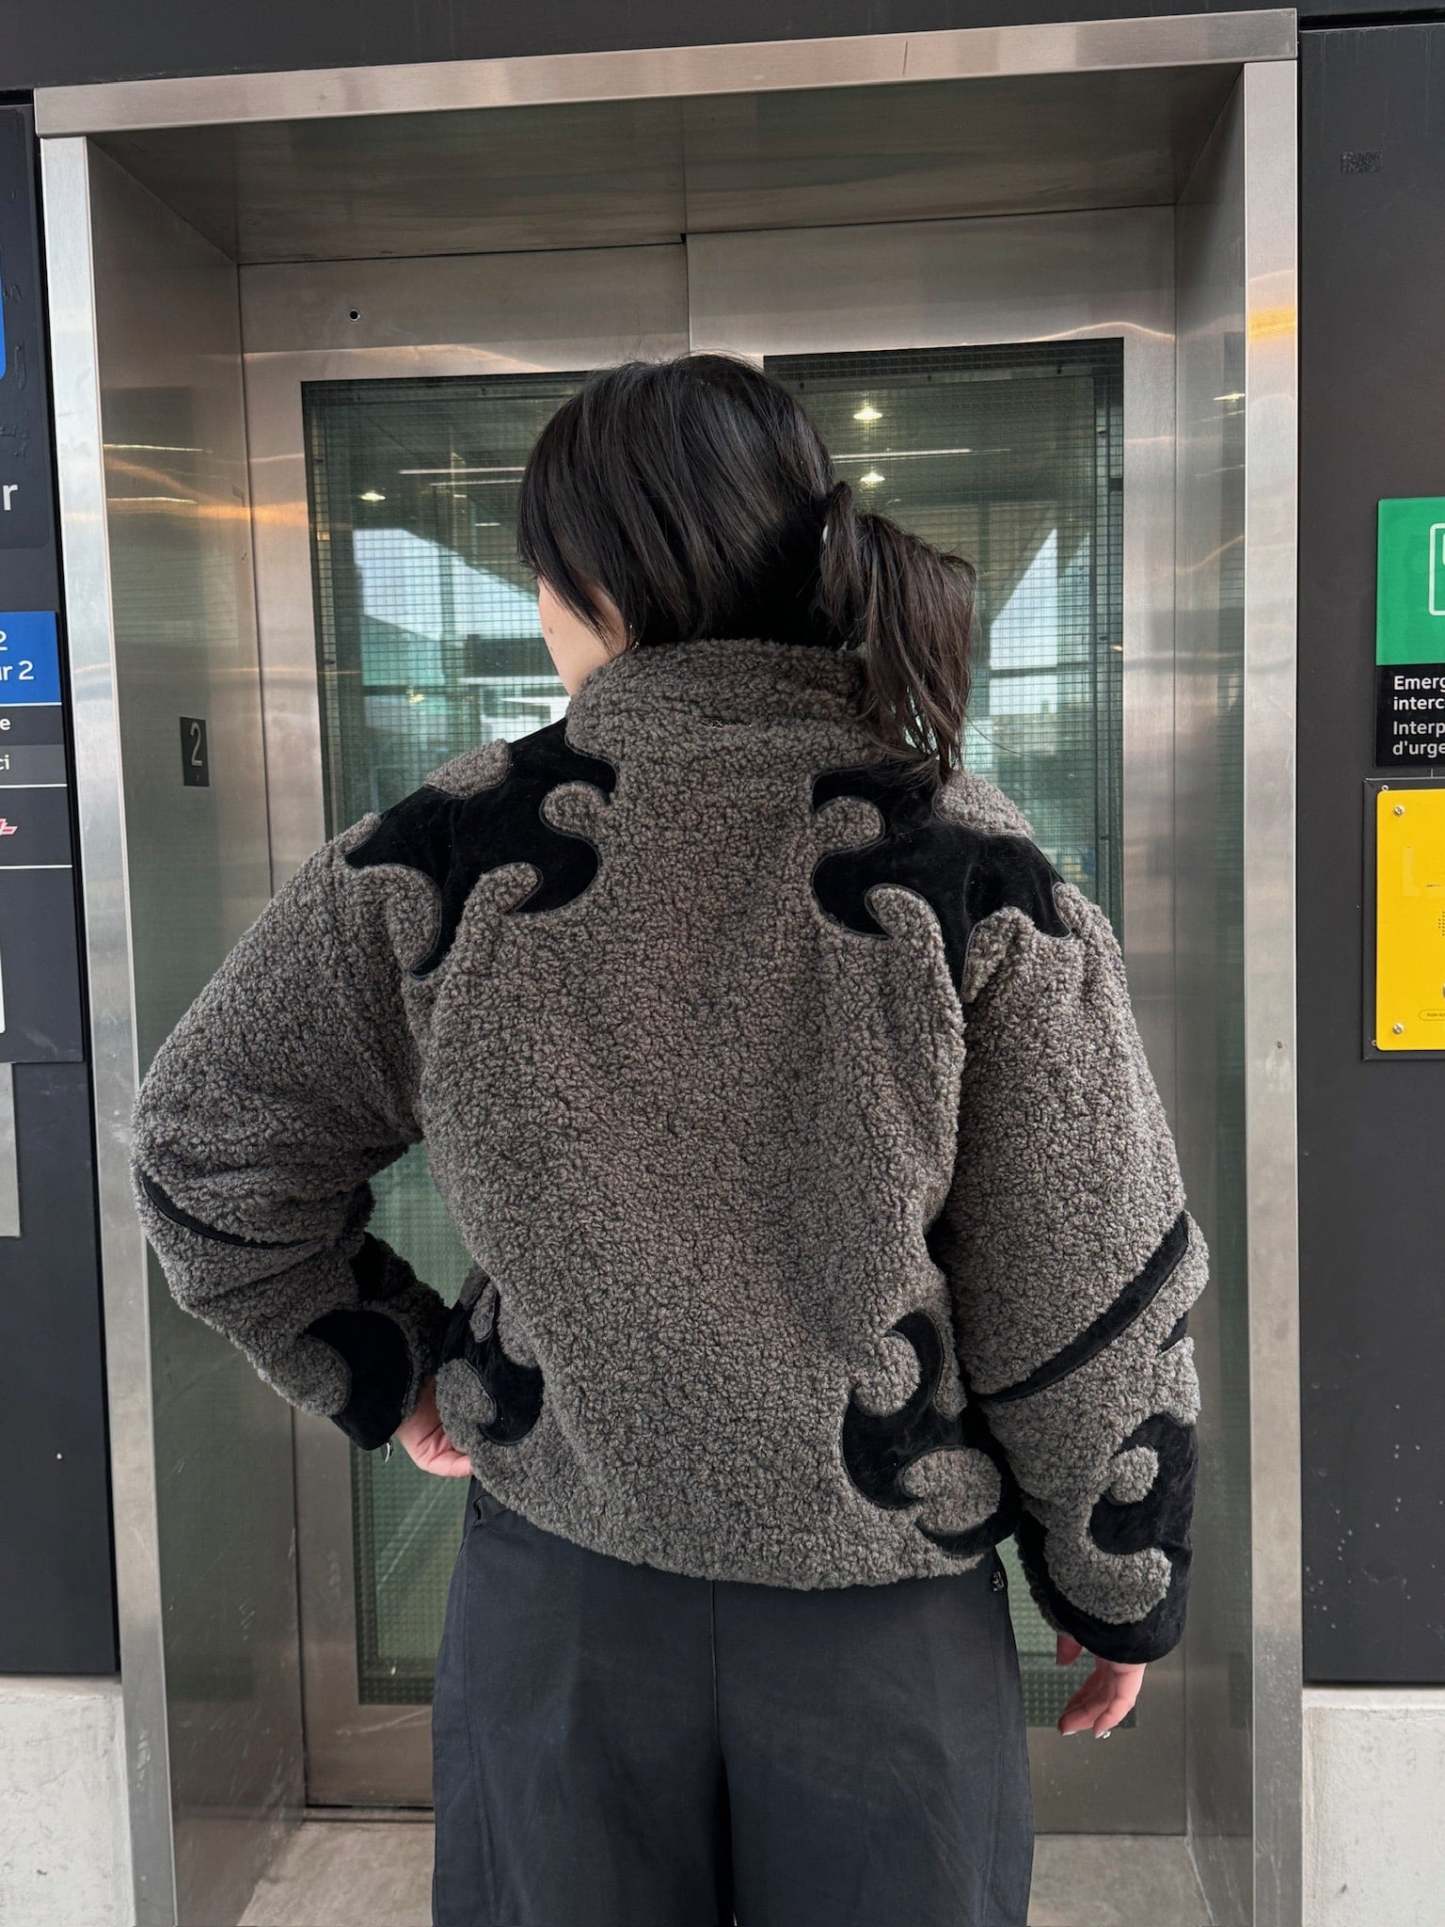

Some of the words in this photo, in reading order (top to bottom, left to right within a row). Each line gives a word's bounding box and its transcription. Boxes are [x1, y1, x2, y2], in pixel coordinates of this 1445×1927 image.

[0, 665, 13, 681] r
[18, 659, 35, 680] 2
[1393, 696, 1445, 711] interc
[1393, 720, 1445, 738] Interp
[190, 721, 203, 767] 2
